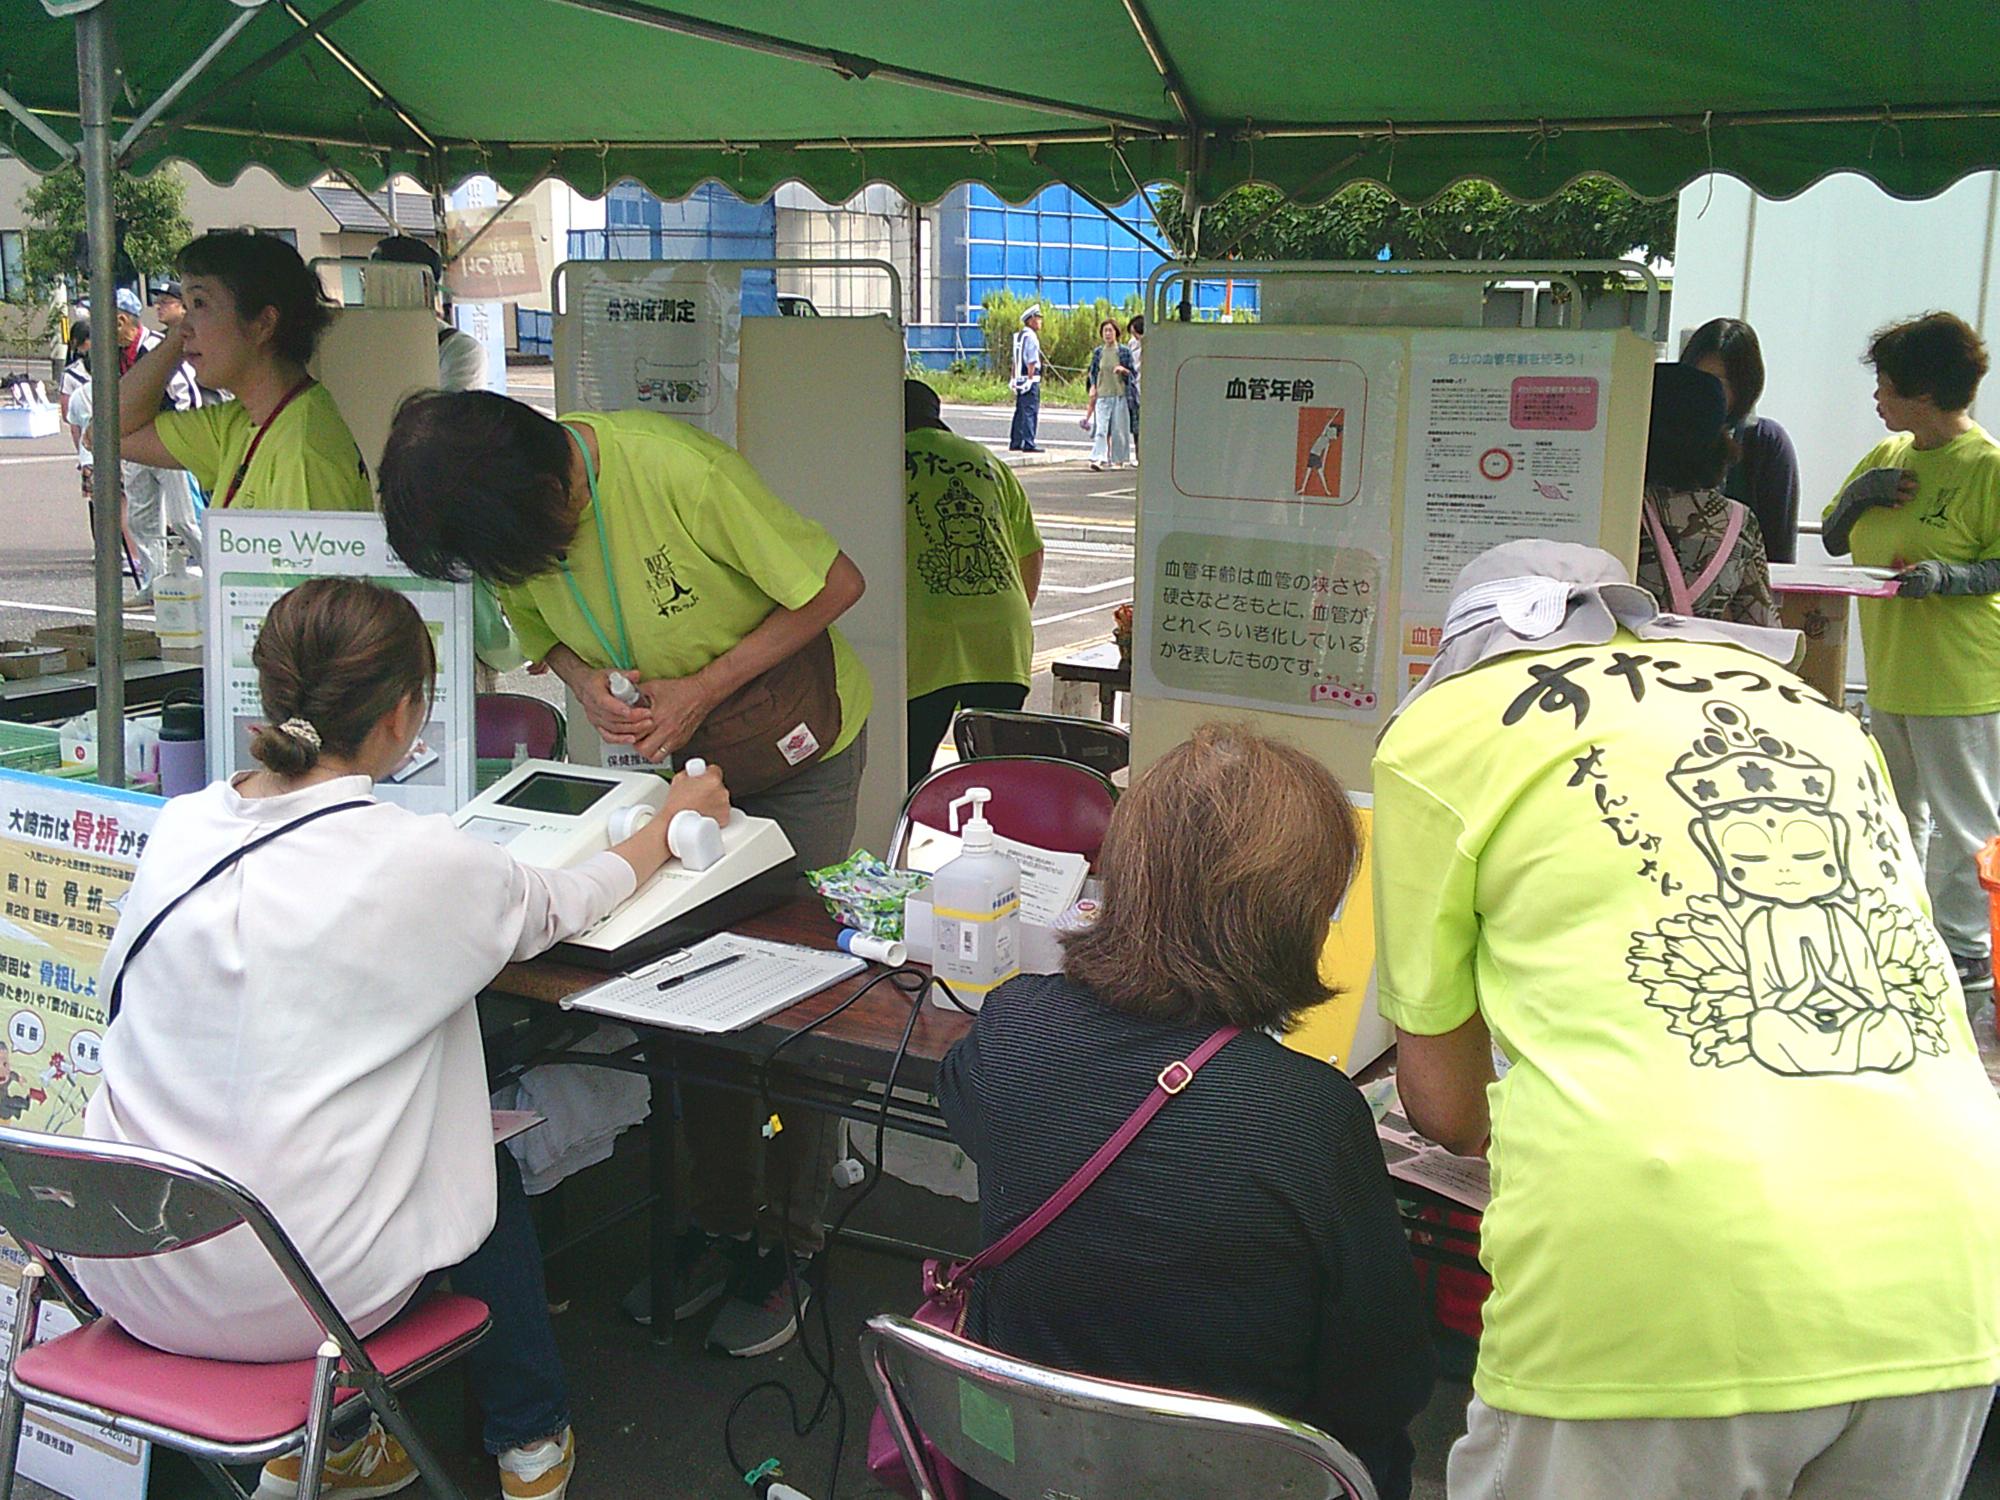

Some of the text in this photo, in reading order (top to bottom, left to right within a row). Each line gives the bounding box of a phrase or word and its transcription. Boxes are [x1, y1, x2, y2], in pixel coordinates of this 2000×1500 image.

[606, 299, 695, 322] 骨強度測定
[1226, 378, 1315, 402] 血管年齢
[220, 528, 365, 557] Bone Wave
[1164, 561, 1370, 596] 血管年齢は血管の狭さや
[1162, 587, 1369, 625] 硬さなどをもとに、血管が
[1161, 614, 1366, 654] どれくらい老化している
[1160, 640, 1321, 679] かを表したものです。
[8, 872, 47, 899] 第1位
